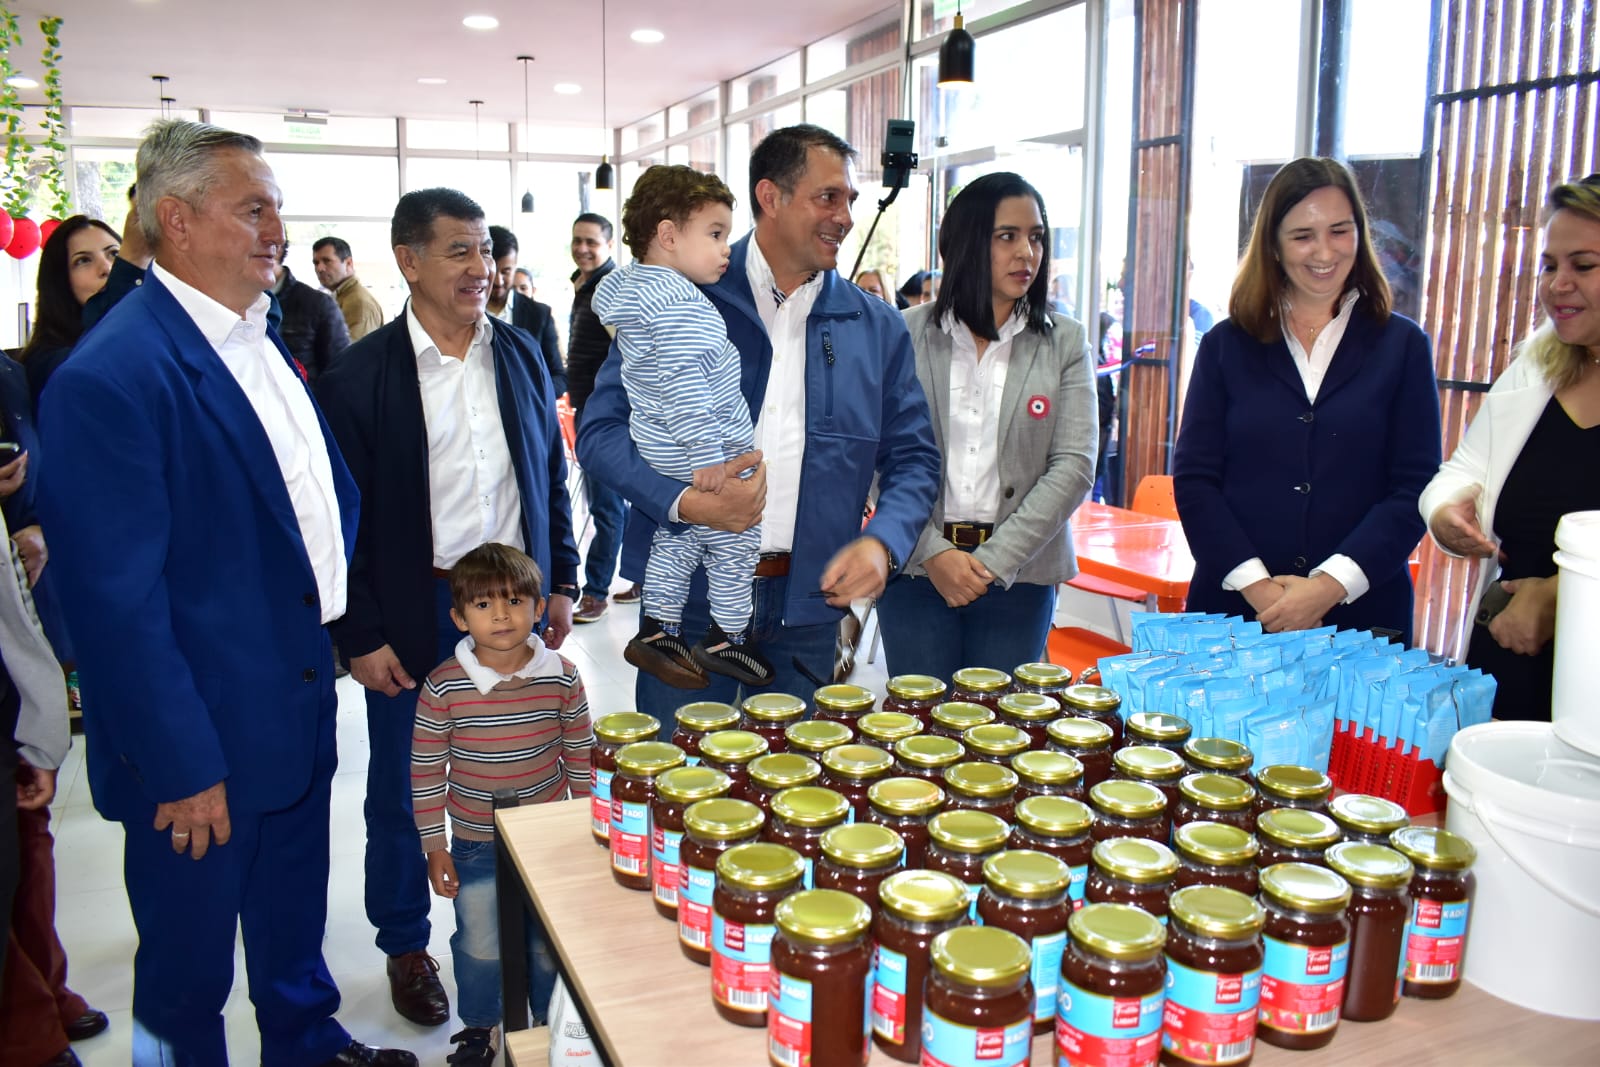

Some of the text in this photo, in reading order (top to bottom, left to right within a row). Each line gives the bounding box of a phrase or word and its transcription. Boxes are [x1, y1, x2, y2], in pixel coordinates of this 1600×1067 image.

[1417, 917, 1440, 926] LIGHT
[724, 938, 744, 949] LIGHT
[1216, 992, 1240, 1001] LIGHT
[976, 1048, 1001, 1057] LIGHT
